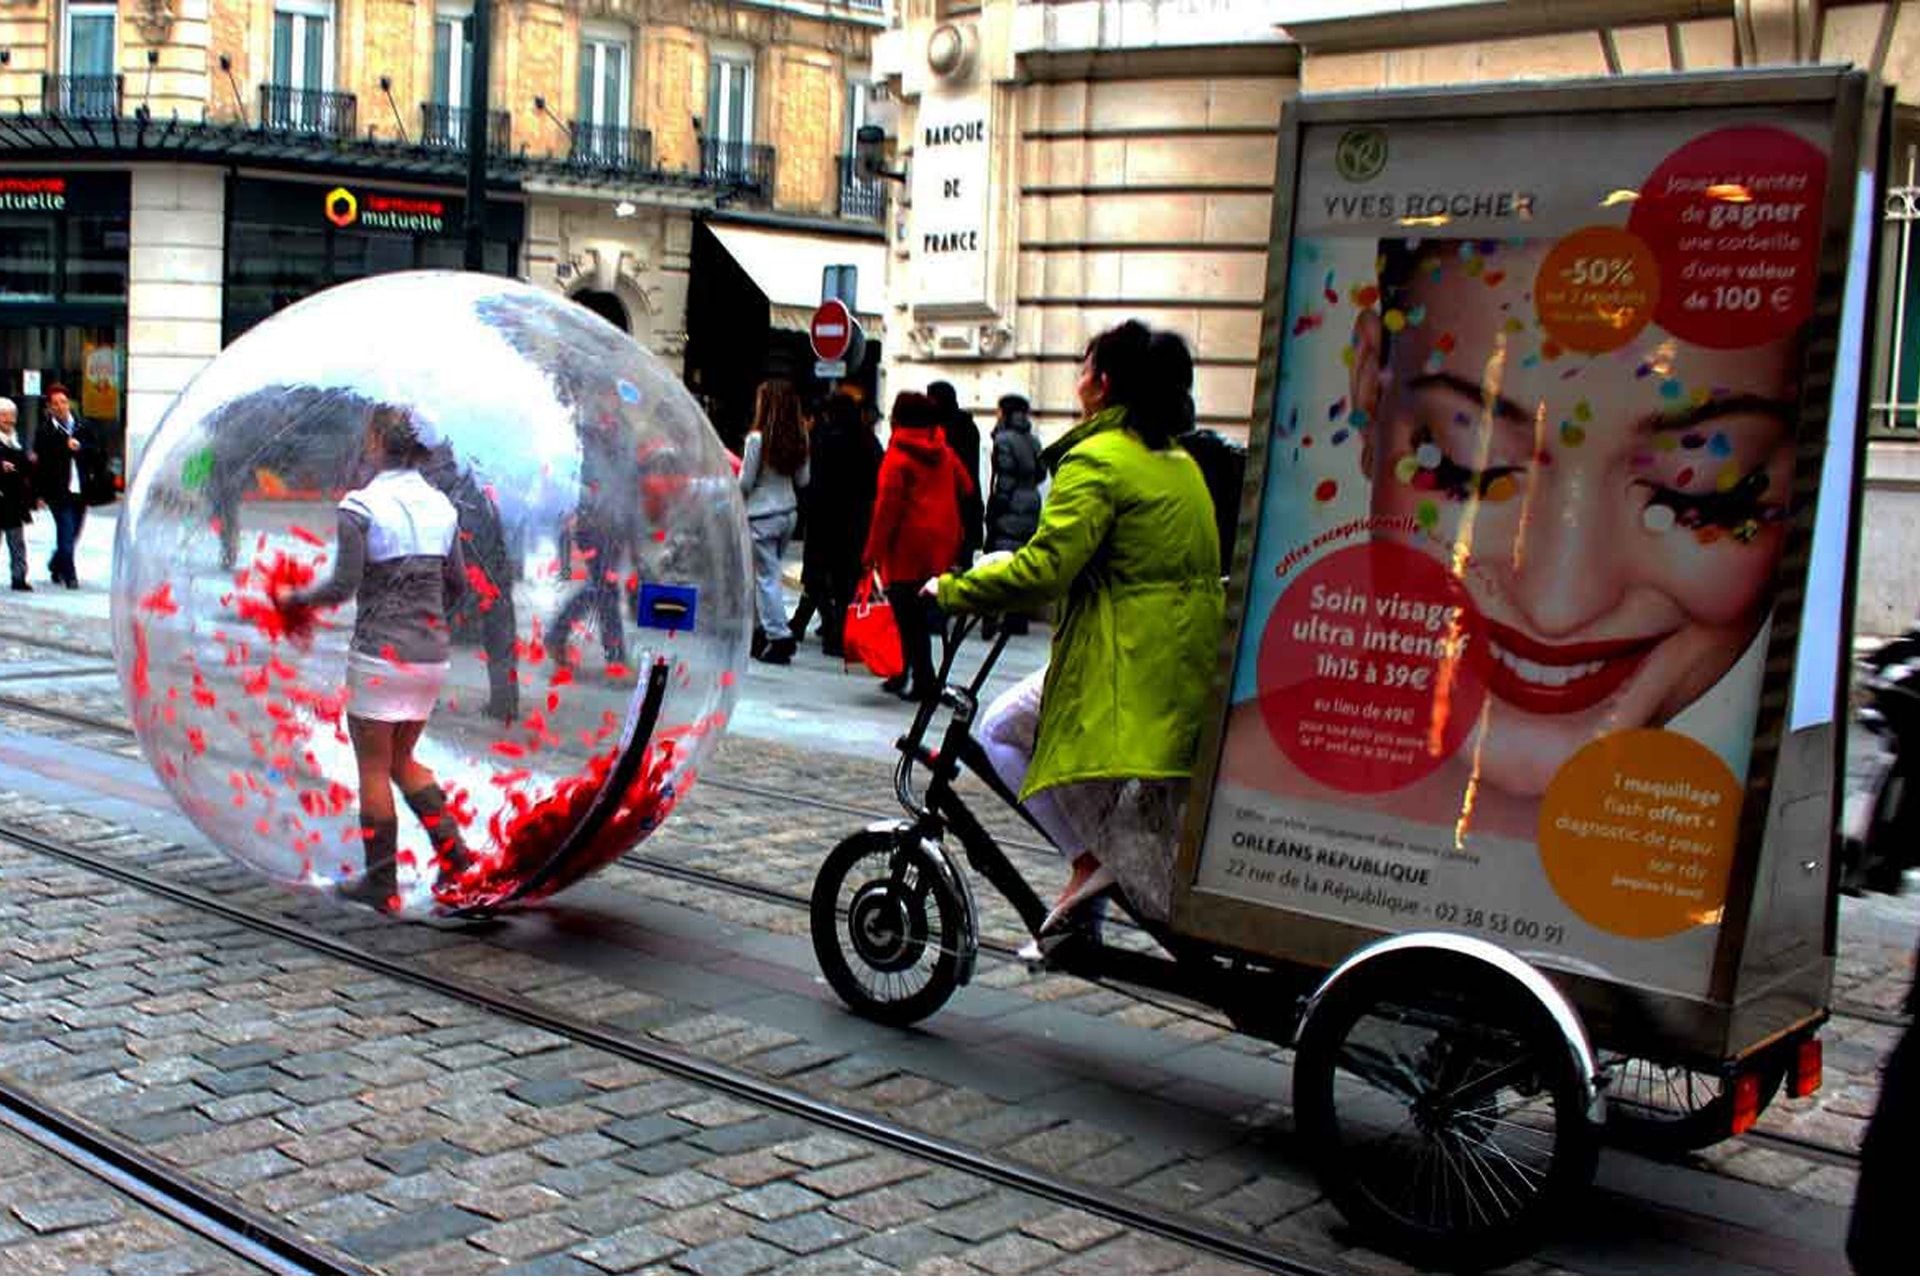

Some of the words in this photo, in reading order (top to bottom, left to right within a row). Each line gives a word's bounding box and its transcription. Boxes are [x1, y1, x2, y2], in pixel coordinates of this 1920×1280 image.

[926, 119, 984, 146] BANQUE
[0, 192, 66, 211] tuelle
[944, 178, 960, 198] DE
[1325, 191, 1393, 218] YVES
[1405, 190, 1536, 218] ROCHER
[1681, 204, 1705, 223] de
[1708, 203, 1806, 230] gagner
[362, 211, 443, 233] mutuelle
[924, 231, 977, 253] FRANCE
[1679, 236, 1713, 251] une
[1560, 258, 1635, 287] -50%
[1736, 260, 1796, 279] valeur
[1682, 291, 1709, 310] de
[1714, 285, 1762, 311] 100
[1310, 584, 1367, 614] Soin
[1376, 592, 1463, 632] visage
[1292, 615, 1355, 647] ultra
[1317, 653, 1359, 681] 1h15
[1382, 664, 1430, 690] 39€
[1624, 777, 1721, 807] maquillage
[1648, 804, 1702, 828] offert
[1231, 830, 1313, 862] ORLEANS
[1225, 858, 1246, 878] 22
[1248, 865, 1274, 884] rue
[1279, 868, 1300, 888] de
[1304, 872, 1319, 893] la
[1321, 879, 1419, 916] République
[1435, 902, 1457, 922] 02
[1464, 907, 1484, 927] 38
[1490, 912, 1508, 933] 53
[1513, 917, 1539, 939] 00
[1545, 924, 1565, 944] 91
